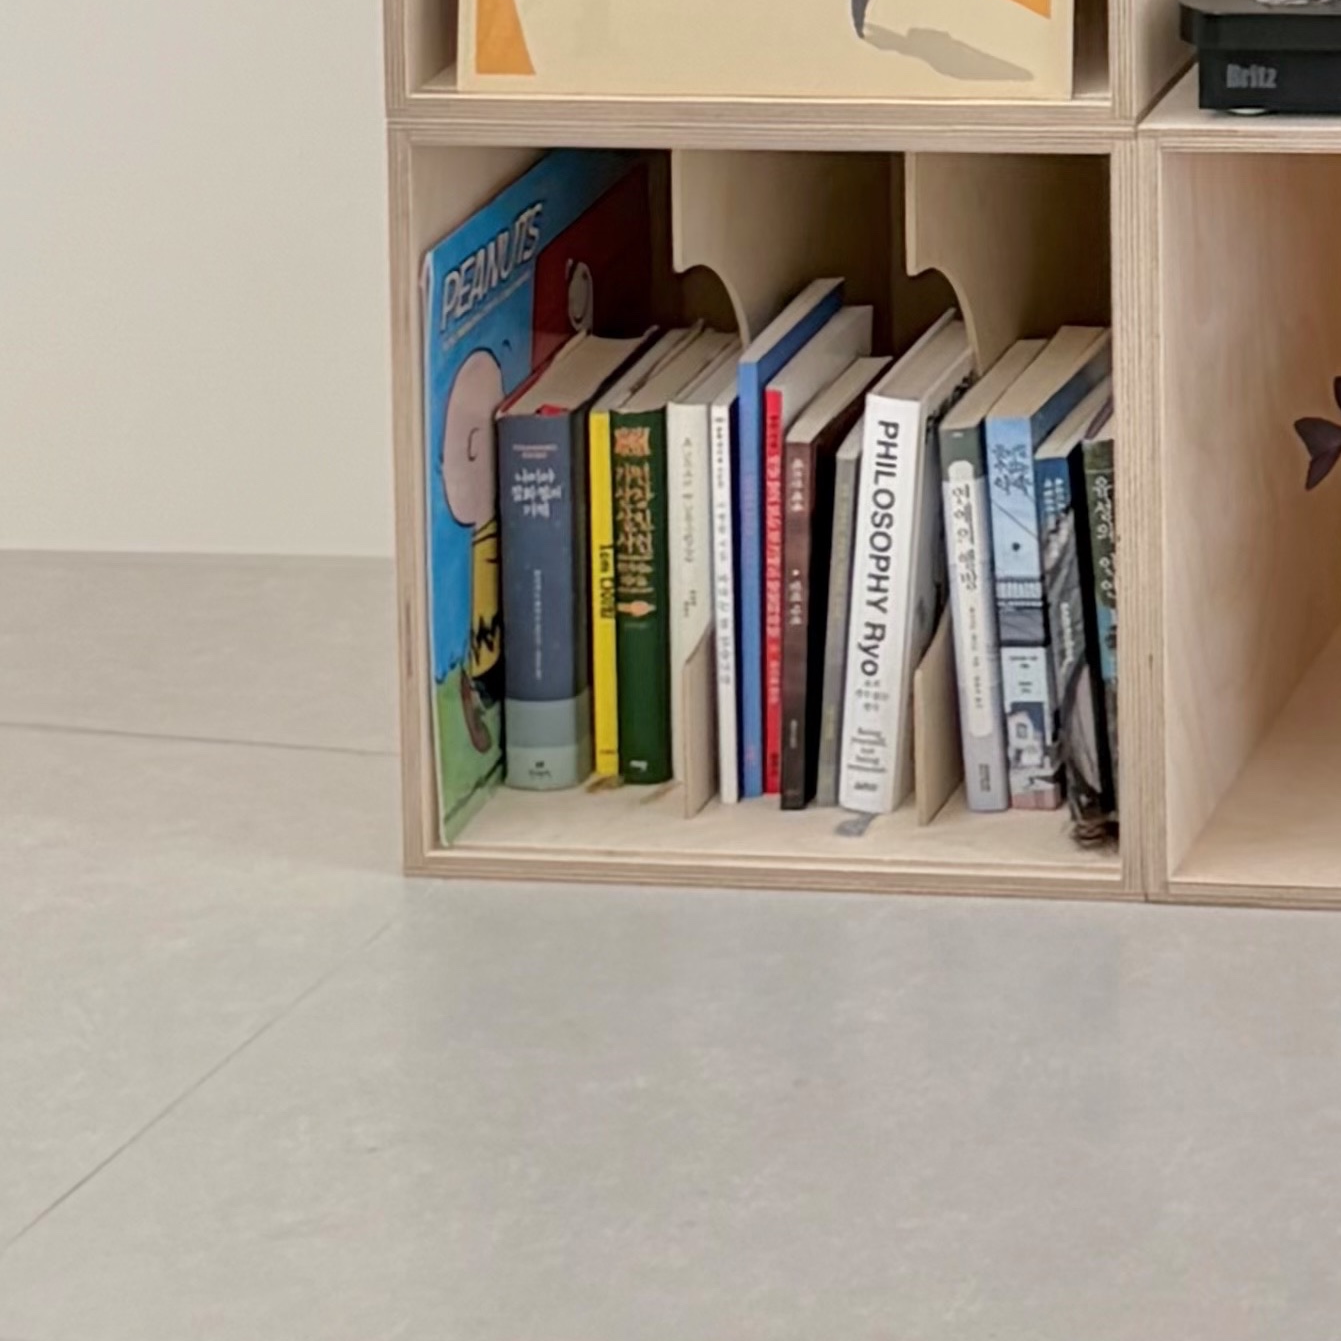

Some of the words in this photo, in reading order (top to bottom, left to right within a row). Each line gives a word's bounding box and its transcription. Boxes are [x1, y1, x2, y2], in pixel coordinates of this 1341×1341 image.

[439, 201, 543, 333] PEANUTS
[865, 419, 899, 615] PHILOSOPHY
[858, 622, 886, 677] Ryo
